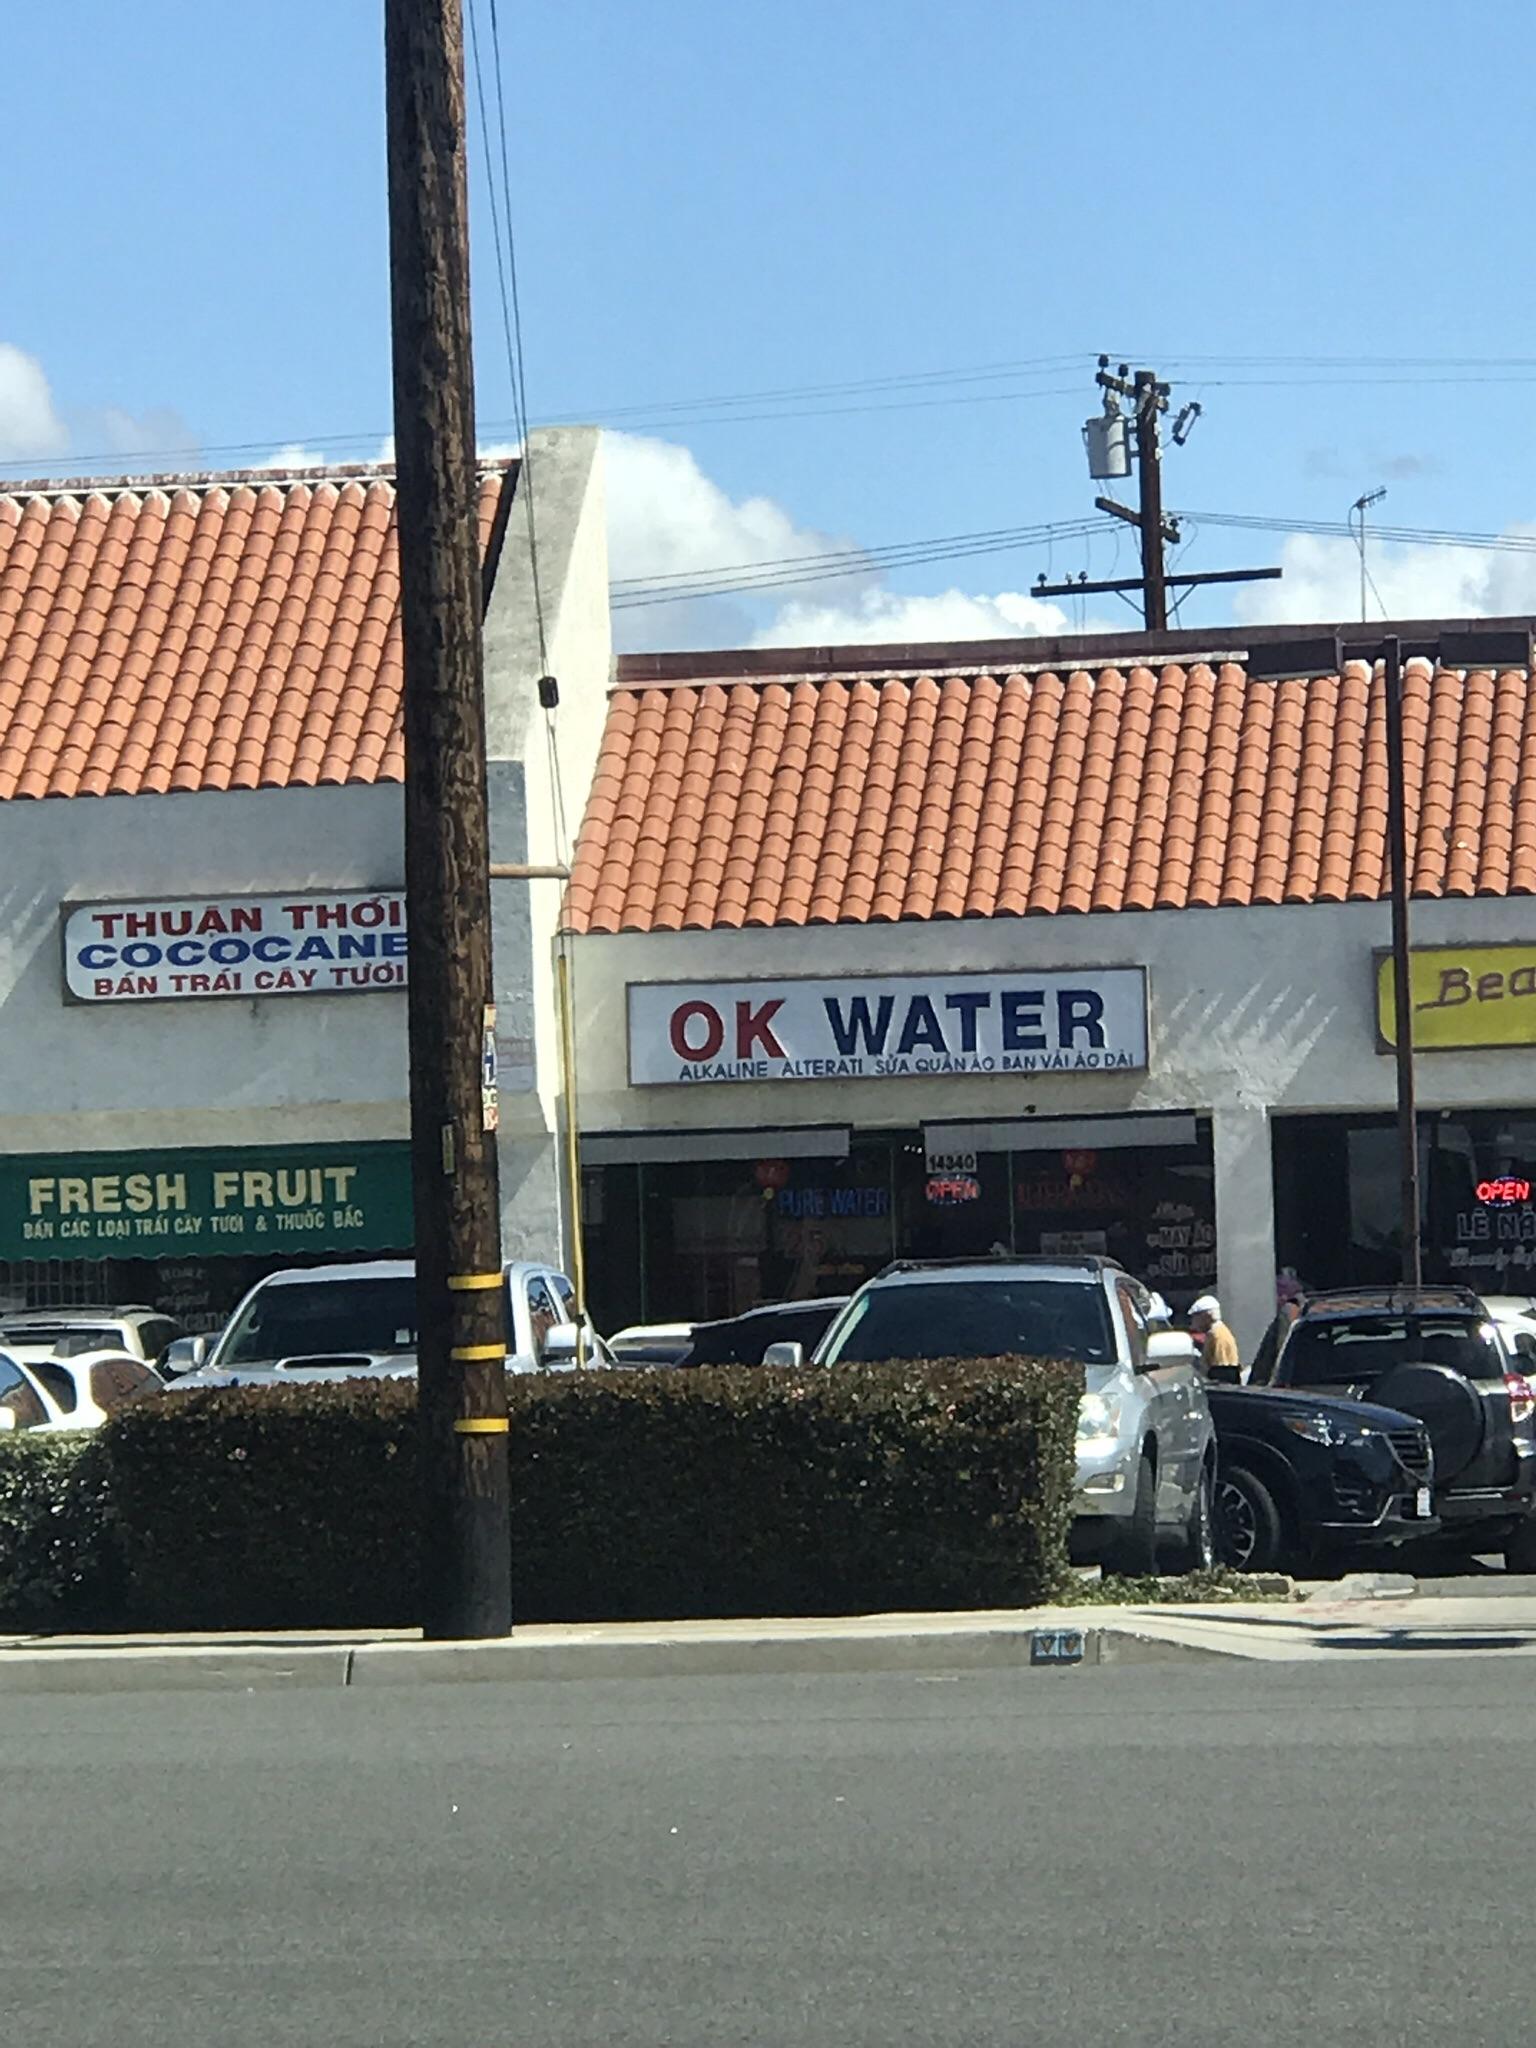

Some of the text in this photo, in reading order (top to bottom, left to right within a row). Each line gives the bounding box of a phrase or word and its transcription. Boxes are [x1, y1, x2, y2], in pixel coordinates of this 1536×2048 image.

[77, 932, 408, 970] COCOCANE
[94, 971, 158, 996] BÁN
[169, 968, 242, 993] TRÁI
[669, 989, 1107, 1062] OK WATER
[679, 1061, 768, 1081] ALKALINE
[781, 1058, 863, 1077] ALTERATI
[928, 1154, 975, 1171] 14340
[29, 1166, 357, 1215] FRESH FRUIT
[779, 1187, 888, 1216] PURE WATER
[926, 1180, 979, 1200] OPEN
[1476, 1182, 1530, 1200] OPEN
[135, 1214, 168, 1236] TRÁI
[255, 1214, 268, 1232] &
